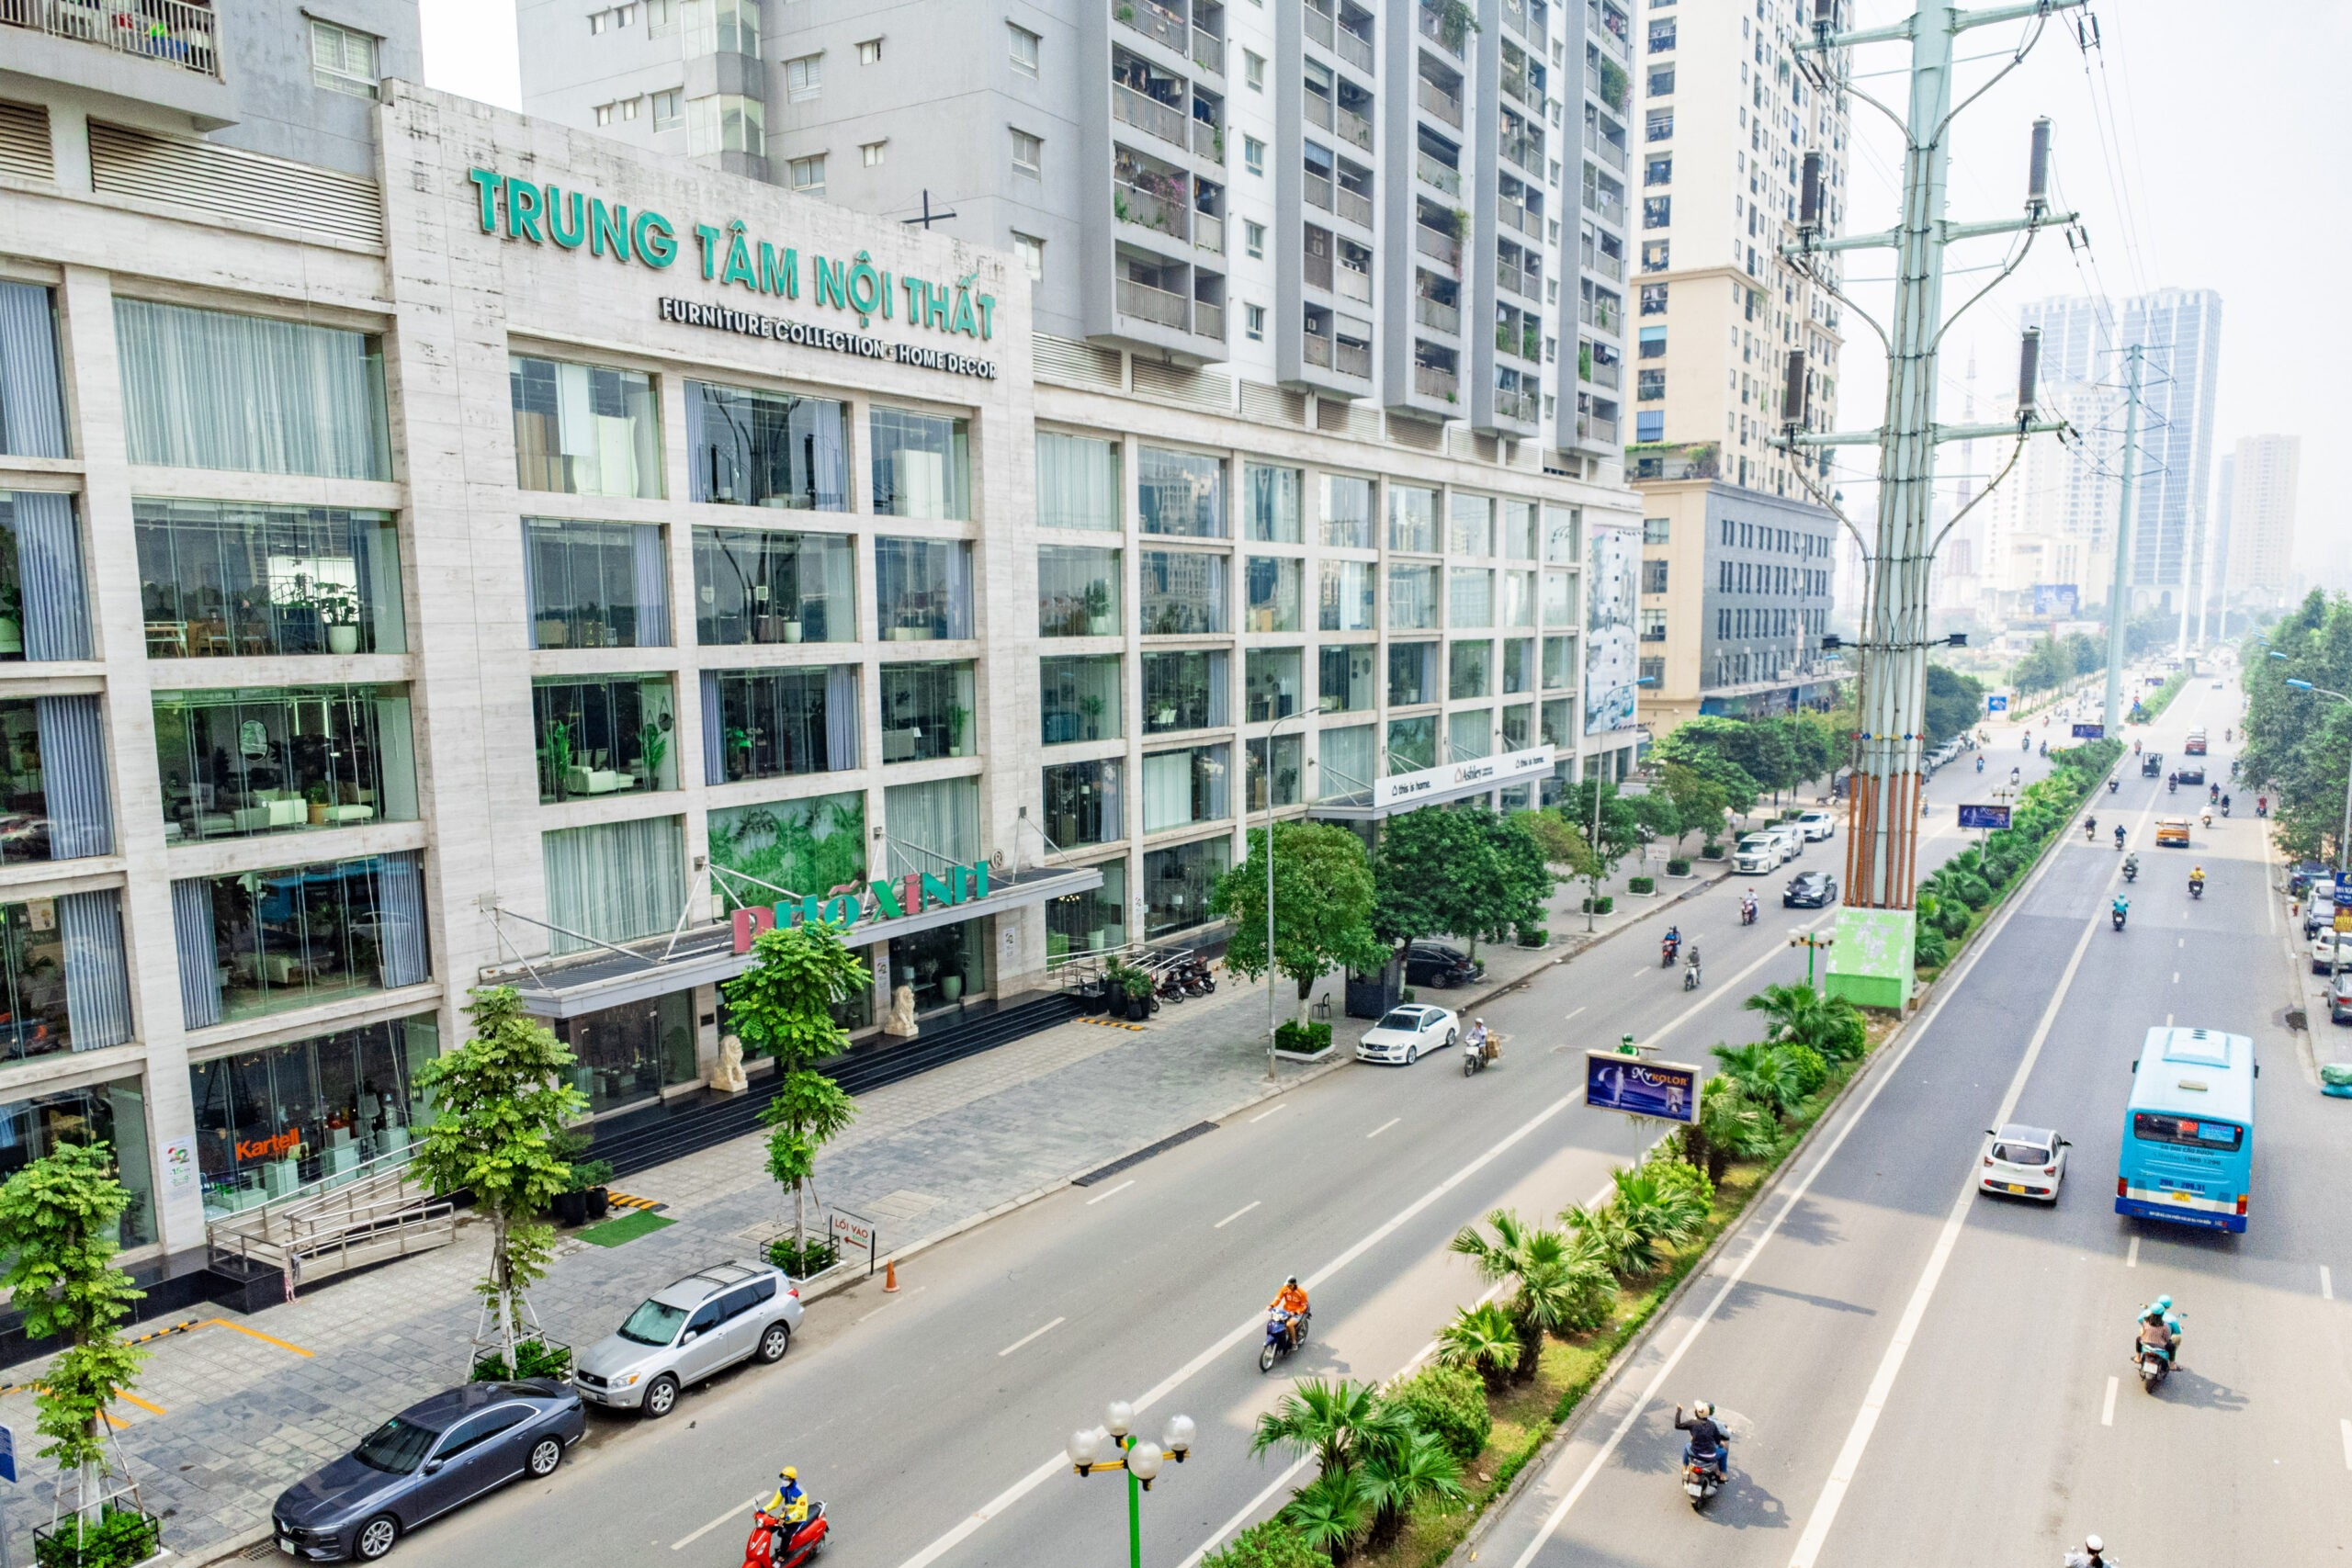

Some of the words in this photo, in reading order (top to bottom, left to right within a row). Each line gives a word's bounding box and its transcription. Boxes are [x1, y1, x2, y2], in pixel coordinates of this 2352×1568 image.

[469, 167, 678, 269] TRUNG
[695, 220, 799, 299] TÂM
[814, 250, 894, 328] NỘI
[902, 273, 996, 340] THẤT
[660, 298, 770, 337] FURNITURE
[775, 320, 885, 357] COLLECTION
[898, 344, 943, 369] HOME
[947, 353, 998, 379] DECOR
[1632, 1067, 1687, 1087] NYKOLOR
[235, 1127, 300, 1162] Kartell
